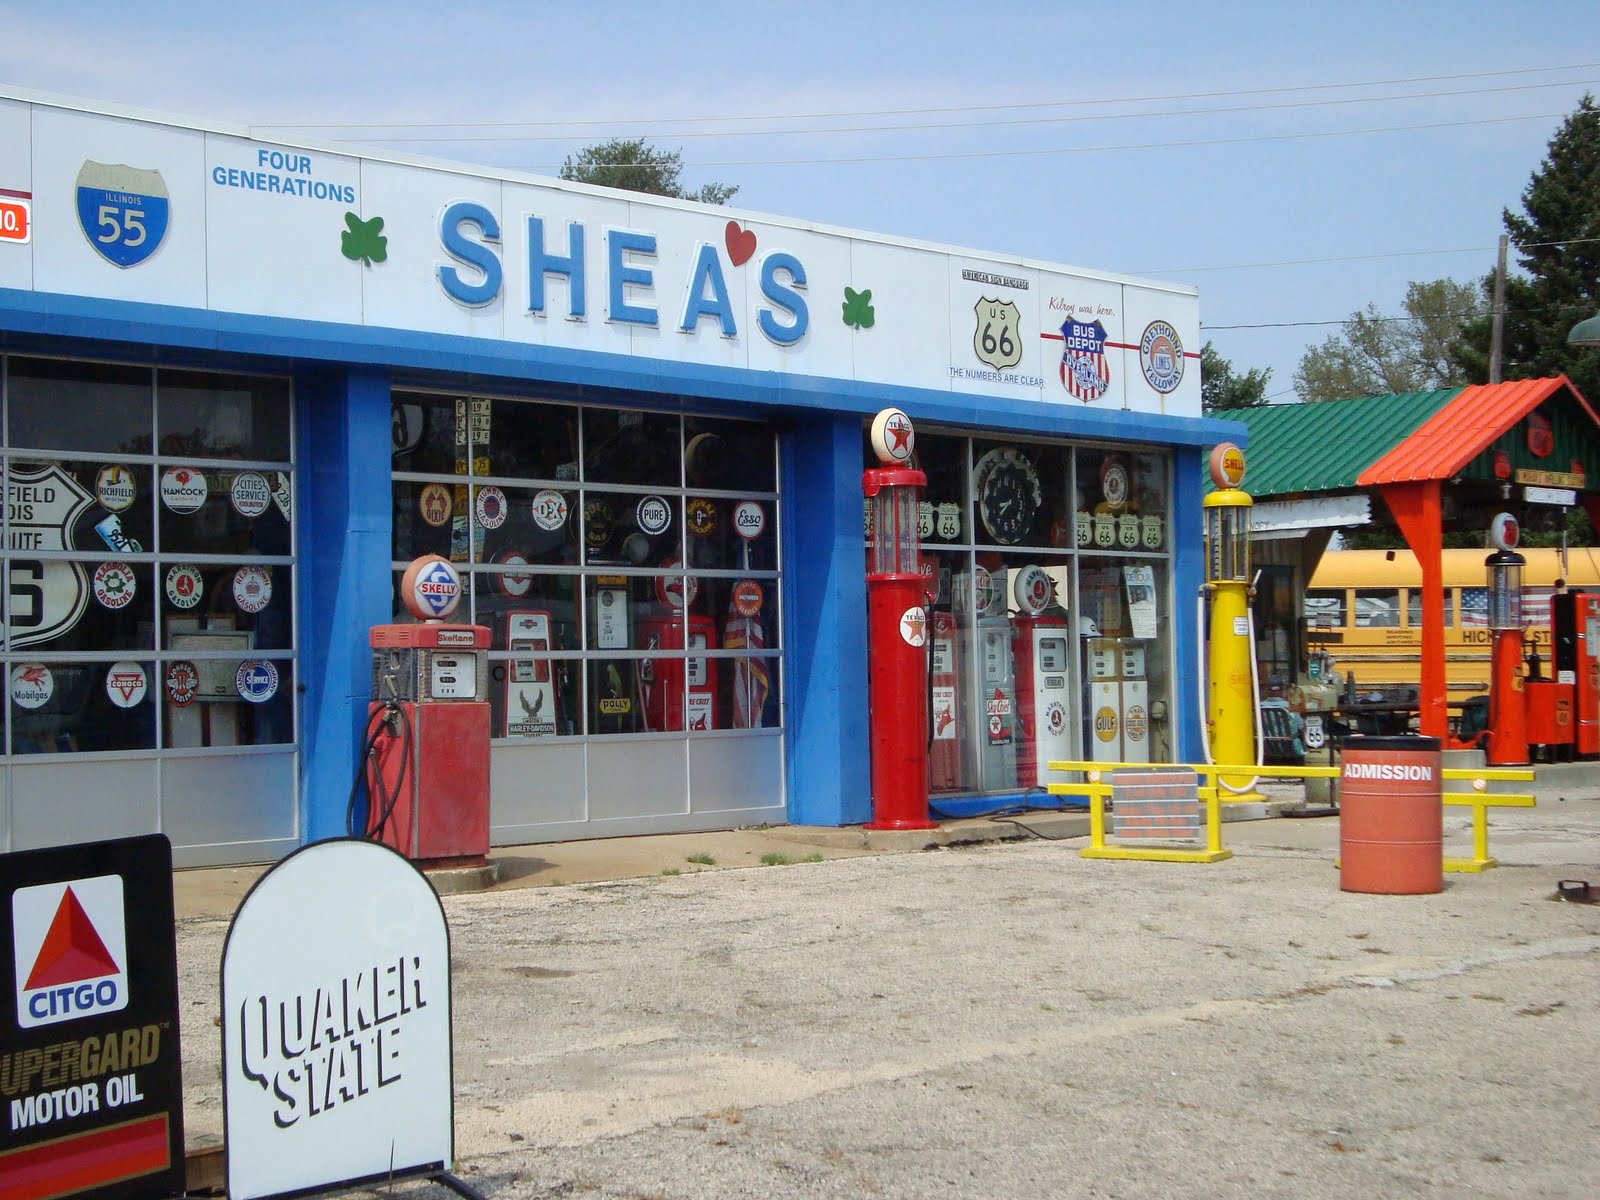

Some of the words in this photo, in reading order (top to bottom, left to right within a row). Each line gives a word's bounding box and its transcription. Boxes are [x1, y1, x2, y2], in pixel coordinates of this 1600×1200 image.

[258, 149, 312, 175] FOUR
[212, 166, 355, 204] GENERATIONS
[104, 192, 142, 206] ILLINOIS
[98, 205, 147, 247] 55
[1048, 296, 1076, 314] Kilroy
[1078, 306, 1093, 314] was
[1096, 303, 1116, 317] here.
[982, 321, 1014, 357] 66
[1073, 324, 1095, 338] BUS
[1067, 336, 1102, 351] DEPOT
[1143, 324, 1182, 359] GREYHOUND
[1155, 355, 1171, 371] LINES
[949, 367, 963, 377] THE
[965, 369, 1002, 382] NUMBERS
[1004, 374, 1019, 384] ARE
[1020, 376, 1044, 387] CLEAR
[1066, 355, 1108, 392] OVERLAND
[1146, 364, 1181, 389] YELLOWAY
[1224, 458, 1244, 471] SHELL
[99, 486, 133, 498] RICHFIELD
[162, 487, 204, 497] HANCOCK
[240, 479, 263, 490] CITIES
[236, 490, 266, 501] SERVICE
[479, 486, 506, 503] HUMBLE
[426, 508, 446, 523] DIXIE
[643, 509, 664, 521] PURE
[687, 499, 715, 516] SIGNAL
[478, 509, 506, 528] GASOLINE
[737, 509, 761, 527] Esso
[943, 522, 955, 535] 66
[1100, 531, 1111, 543] 66
[1124, 532, 1135, 544] 66
[1146, 532, 1158, 545] 66
[96, 561, 133, 583] MAGNOLIA
[168, 564, 202, 585] MARATHON
[236, 567, 248, 585] RED
[250, 565, 271, 586] CROWN
[421, 583, 456, 595] SKELLY
[96, 588, 133, 607] GASOLINE
[168, 590, 201, 607] GASOLINE
[236, 594, 268, 612] GASOLINE
[170, 663, 195, 679] JOHNSON
[111, 680, 142, 688] CONOCO
[14, 690, 49, 702] Mobilgas
[603, 700, 628, 710] POLLY
[997, 699, 1010, 713] Chief
[1045, 701, 1066, 717] MARATHON
[510, 723, 554, 733] HARLEY-DAVIDSON
[1096, 716, 1115, 731] GULF
[1309, 728, 1321, 743] 66
[1344, 763, 1432, 781] ADMISSION
[29, 980, 117, 1019] CITGO
[240, 956, 426, 1091] QUAKER
[273, 1027, 402, 1129] STATE
[11, 1082, 100, 1131] MOTOR
[106, 1073, 144, 1107] OIL
